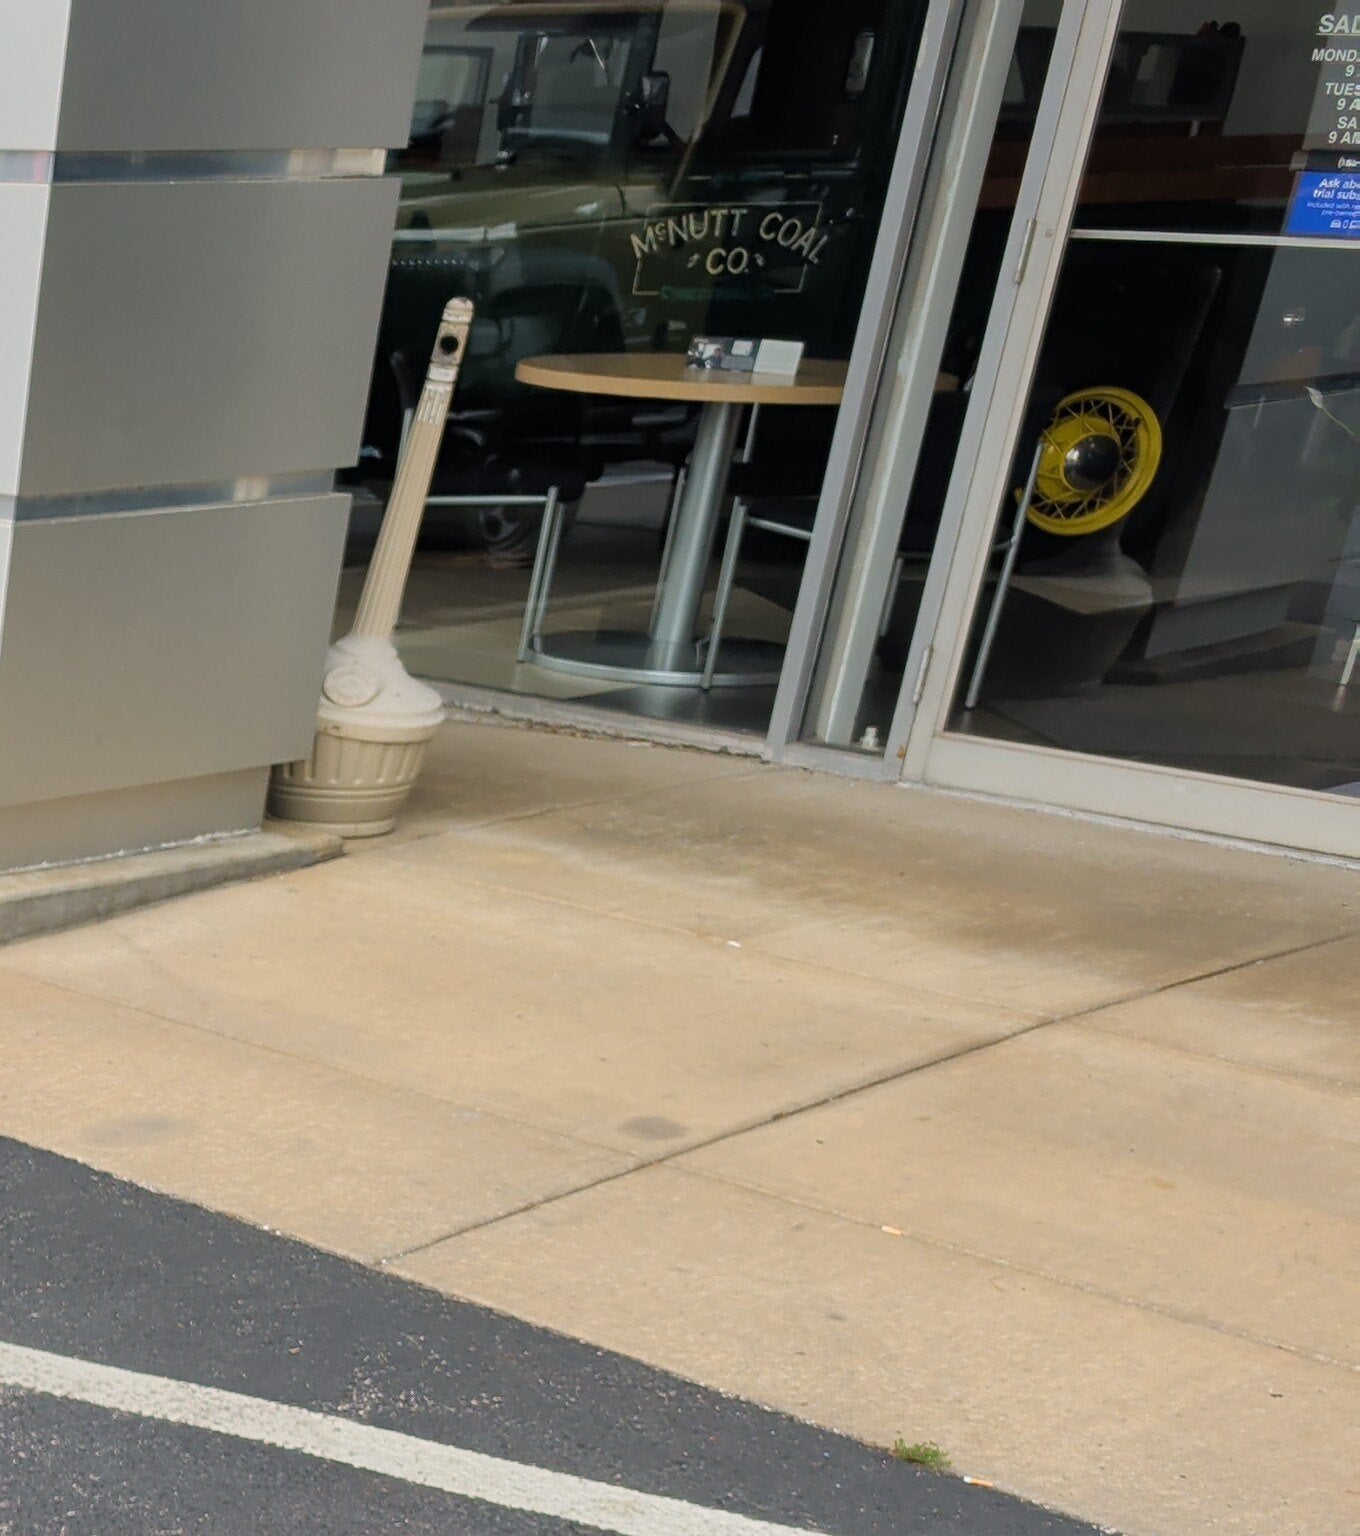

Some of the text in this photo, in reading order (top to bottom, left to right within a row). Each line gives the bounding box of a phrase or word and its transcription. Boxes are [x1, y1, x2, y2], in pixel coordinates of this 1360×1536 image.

[1336, 98, 1346, 110] 9
[1328, 131, 1338, 144] 9
[1319, 178, 1340, 188] Ask
[1313, 188, 1335, 199] trial
[758, 211, 829, 265] COAL
